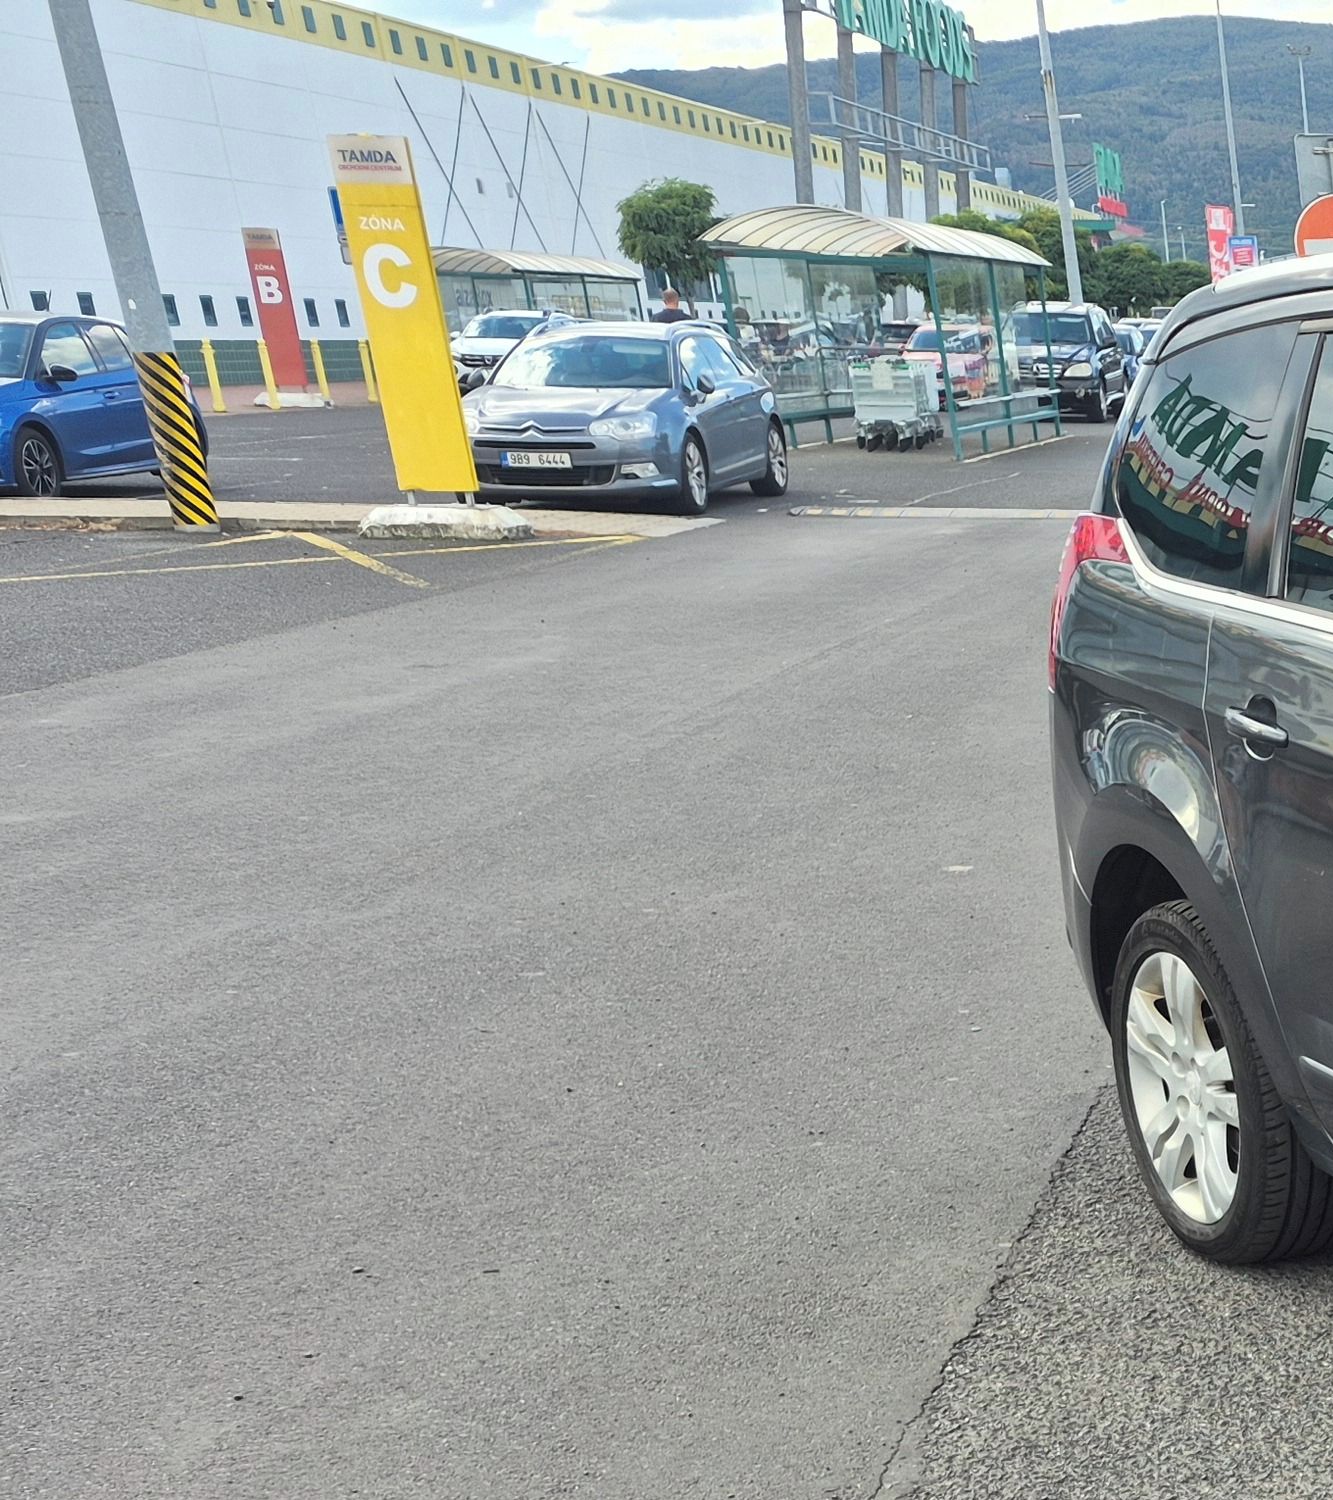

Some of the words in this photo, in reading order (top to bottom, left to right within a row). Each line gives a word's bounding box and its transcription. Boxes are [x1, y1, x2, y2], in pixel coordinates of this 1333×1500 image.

[336, 149, 397, 164] TAMDA
[358, 214, 405, 231] ZÓNA
[363, 243, 418, 308] C
[256, 276, 283, 304] B
[510, 453, 531, 464] 9B9
[538, 454, 565, 465] 6444
